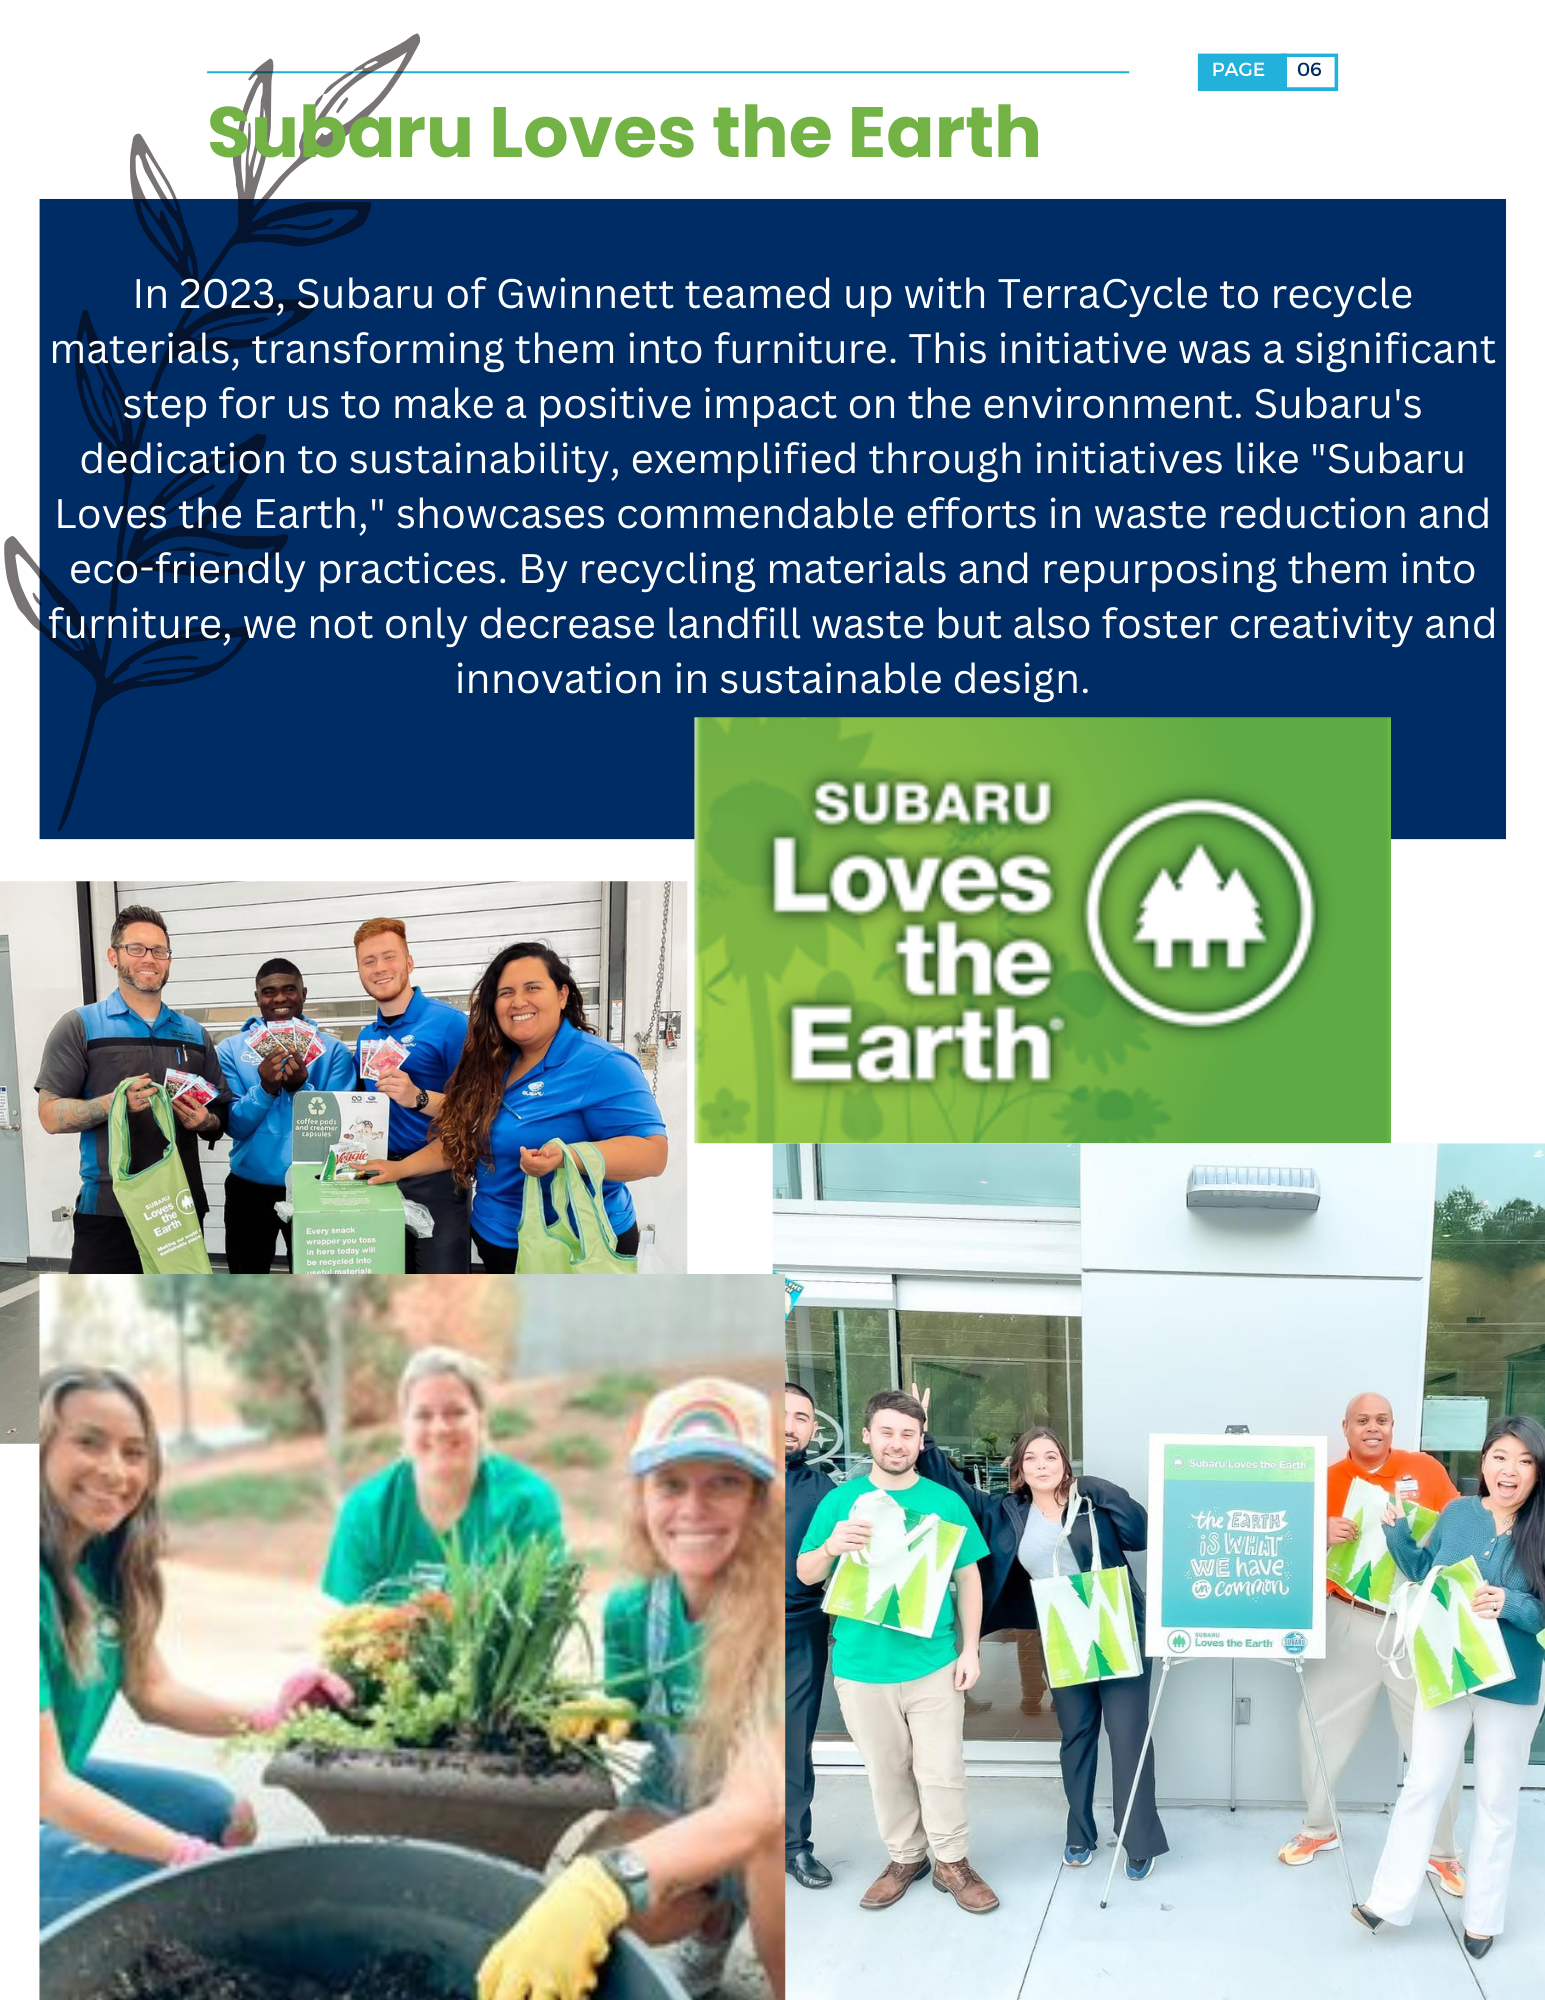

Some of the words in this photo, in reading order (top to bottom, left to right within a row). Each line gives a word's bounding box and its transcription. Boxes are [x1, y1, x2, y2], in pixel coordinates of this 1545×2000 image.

[320, 1118, 337, 1126] pods
[335, 1149, 369, 1164] Veggie
[145, 1195, 171, 1210] SUBARU
[143, 1203, 175, 1221] Loves
[161, 1211, 178, 1223] the
[153, 1219, 182, 1237] Earth
[306, 1228, 329, 1236] Every
[342, 1238, 357, 1246] you
[337, 1247, 360, 1256] today
[362, 1246, 376, 1254] will
[319, 1257, 354, 1268] recycled
[1189, 1459, 1226, 1469] Subaru
[1228, 1459, 1258, 1469] Loves
[1260, 1460, 1277, 1469] the
[1278, 1460, 1307, 1470] Earth
[1191, 1510, 1224, 1530] the
[1224, 1533, 1283, 1557] WHAT
[1190, 1557, 1230, 1578] WE
[1236, 1557, 1285, 1577] have
[1214, 1579, 1290, 1597] common
[1195, 1638, 1225, 1648] Loves
[1226, 1638, 1243, 1648] the
[1245, 1639, 1273, 1648] Earth
